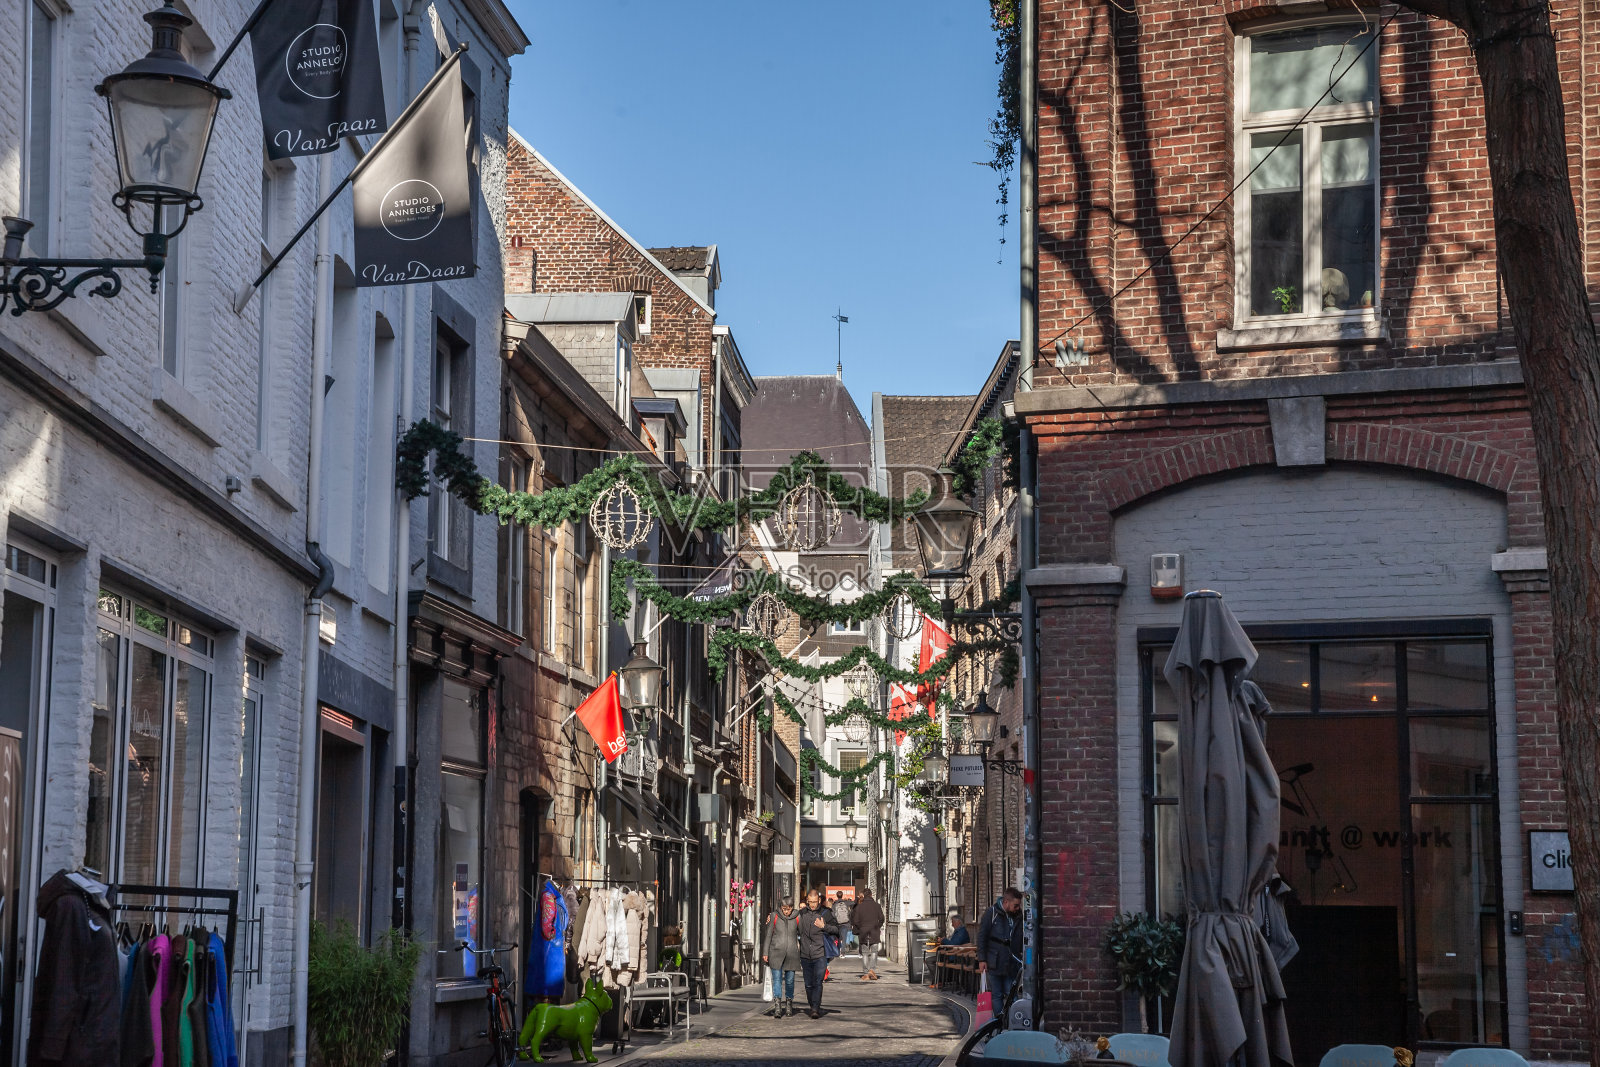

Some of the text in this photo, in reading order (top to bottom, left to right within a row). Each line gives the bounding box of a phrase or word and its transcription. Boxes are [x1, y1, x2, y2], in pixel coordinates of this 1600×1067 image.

[302, 45, 341, 58] STUDIO
[394, 196, 429, 208] STUDIO
[388, 205, 436, 218] ANNELOES
[1341, 825, 1363, 850] @
[810, 847, 845, 859] SHOP
